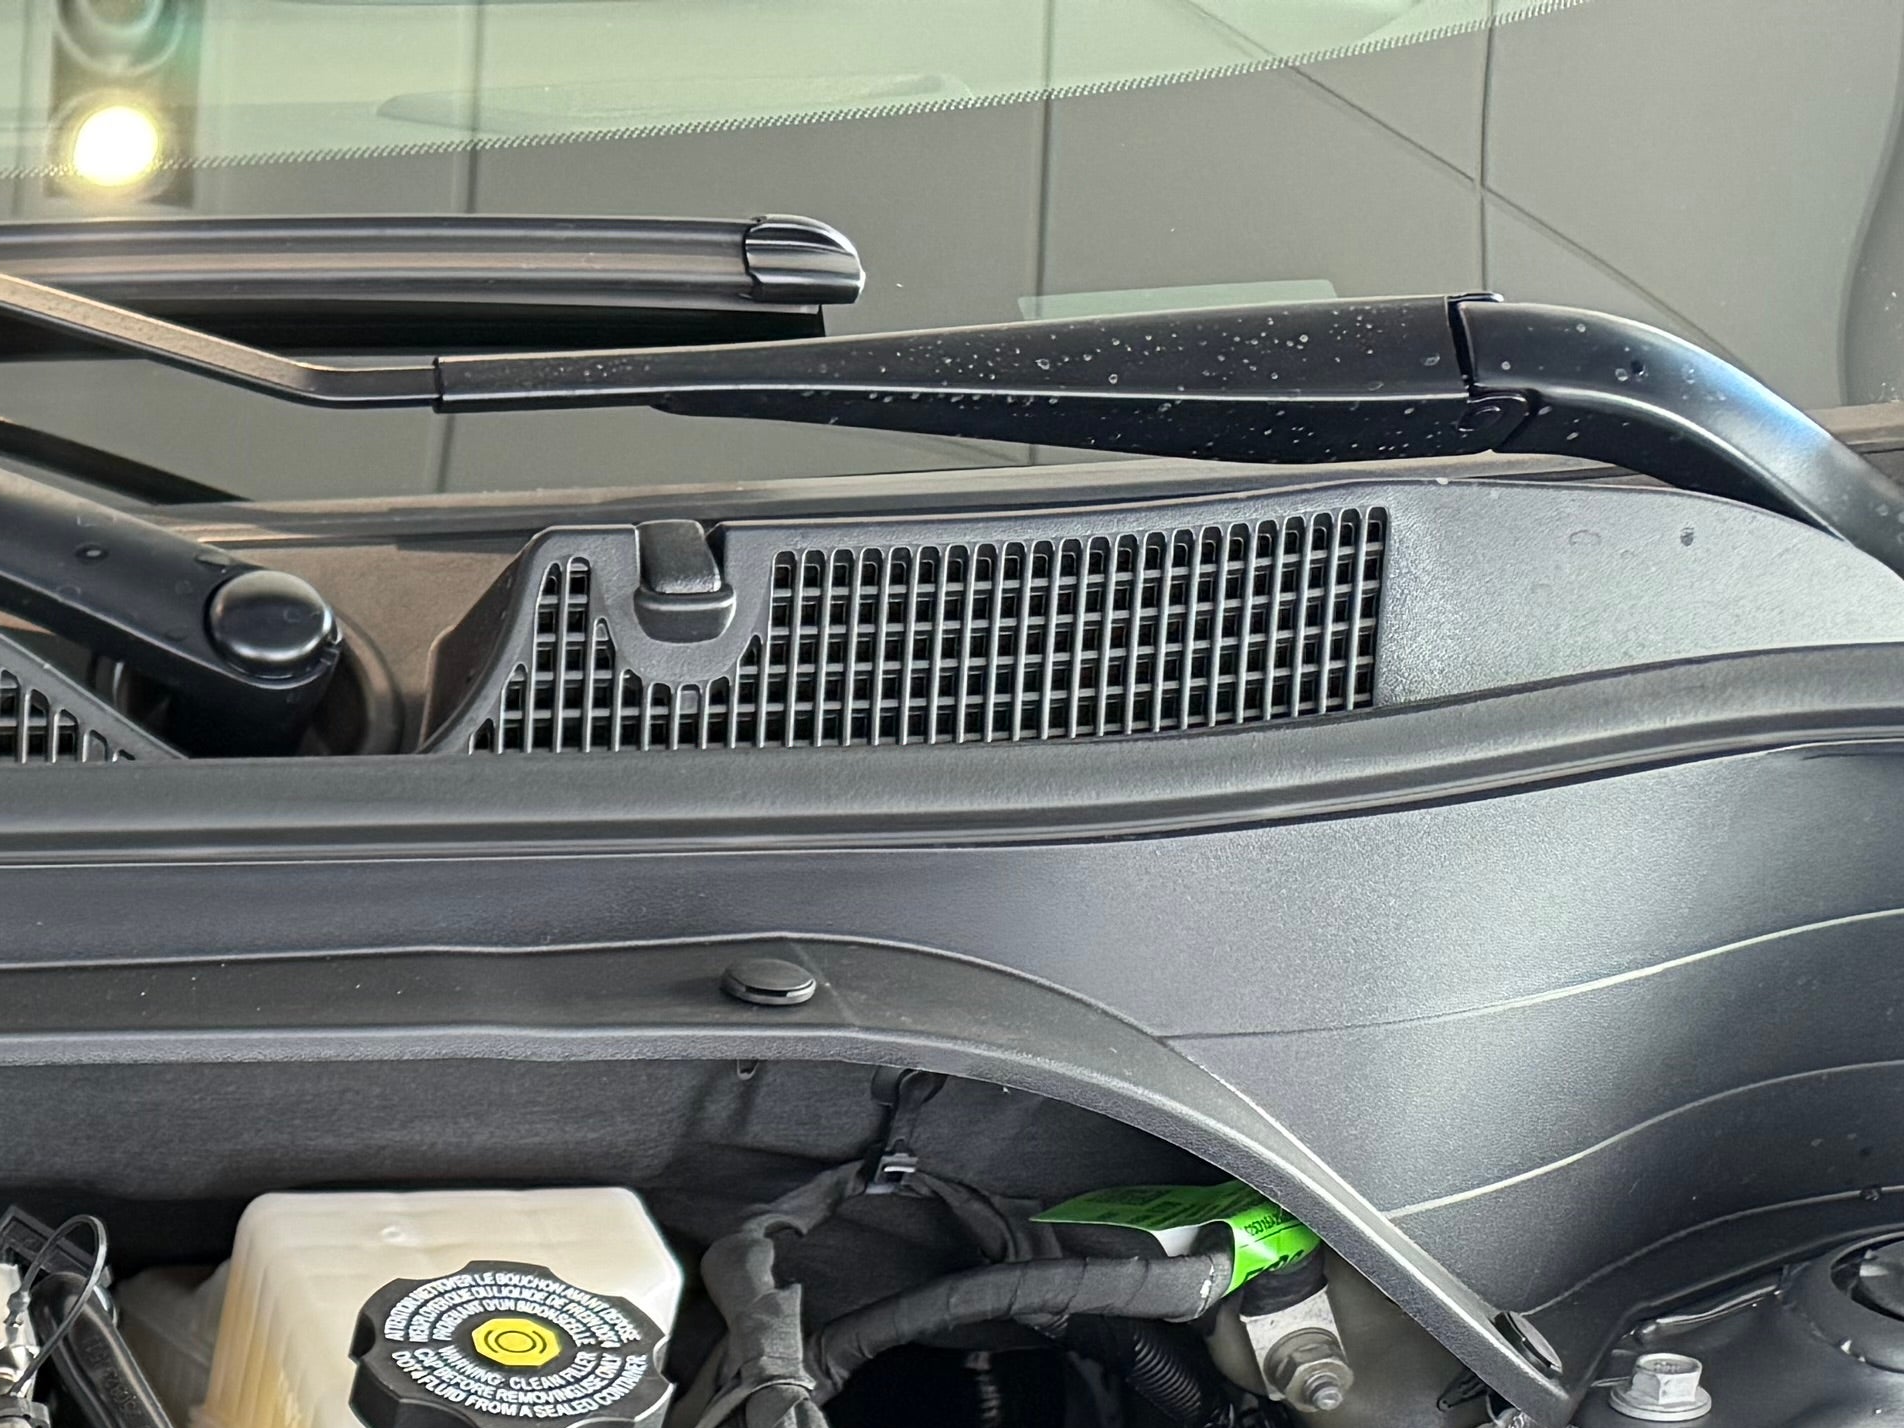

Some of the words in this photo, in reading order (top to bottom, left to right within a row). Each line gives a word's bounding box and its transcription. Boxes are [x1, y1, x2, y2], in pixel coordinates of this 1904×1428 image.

[471, 1286, 492, 1298] DU
[493, 1286, 548, 1303] LIQUIDE
[546, 1295, 569, 1309] DE
[474, 1272, 495, 1286] LE
[495, 1273, 565, 1294] BOUCHON
[562, 1287, 610, 1312] AVANT
[516, 1300, 560, 1322] BIDON
[414, 1348, 444, 1371] CAP
[437, 1363, 494, 1398] BEFORE
[599, 1352, 622, 1380] ONLY
[417, 1374, 468, 1402] FLUID
[465, 1395, 517, 1417] FROM
[518, 1406, 534, 1418] A
[533, 1399, 599, 1418] SEALED
[593, 1354, 648, 1406] CONTAINER
[509, 1374, 565, 1390] CLEAN
[561, 1351, 597, 1384] FILLER
